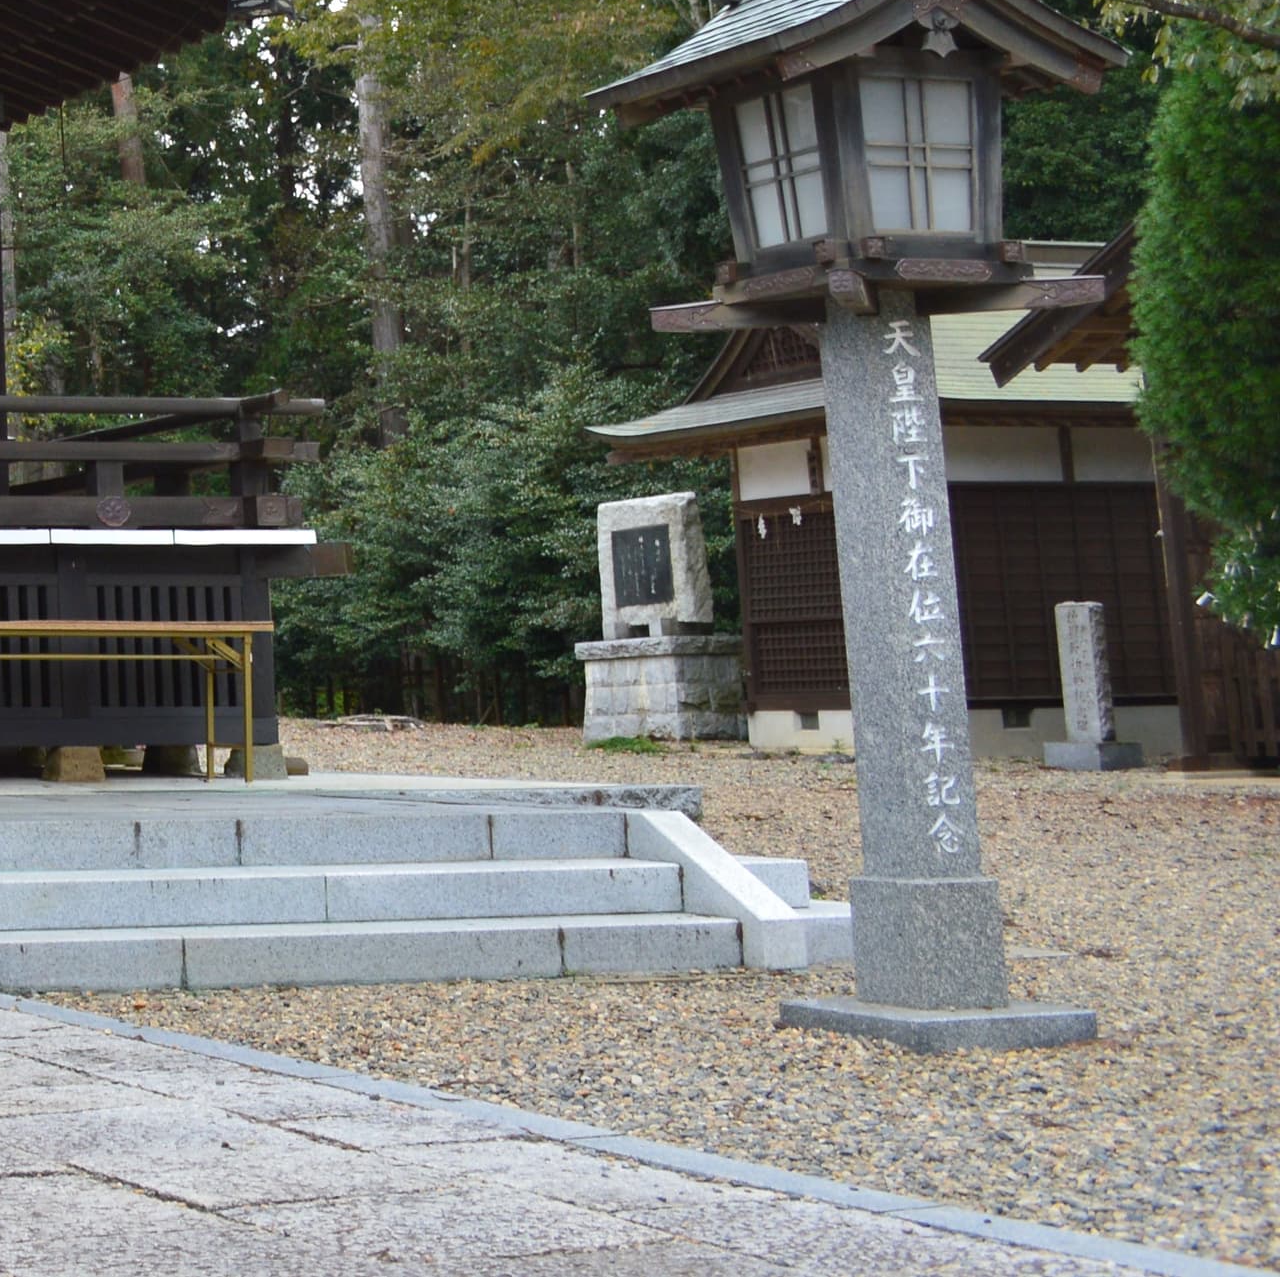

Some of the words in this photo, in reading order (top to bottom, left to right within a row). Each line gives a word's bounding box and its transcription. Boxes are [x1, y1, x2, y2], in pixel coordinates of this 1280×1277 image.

[883, 321, 964, 854] 天皇陛下御在位六十年記念
